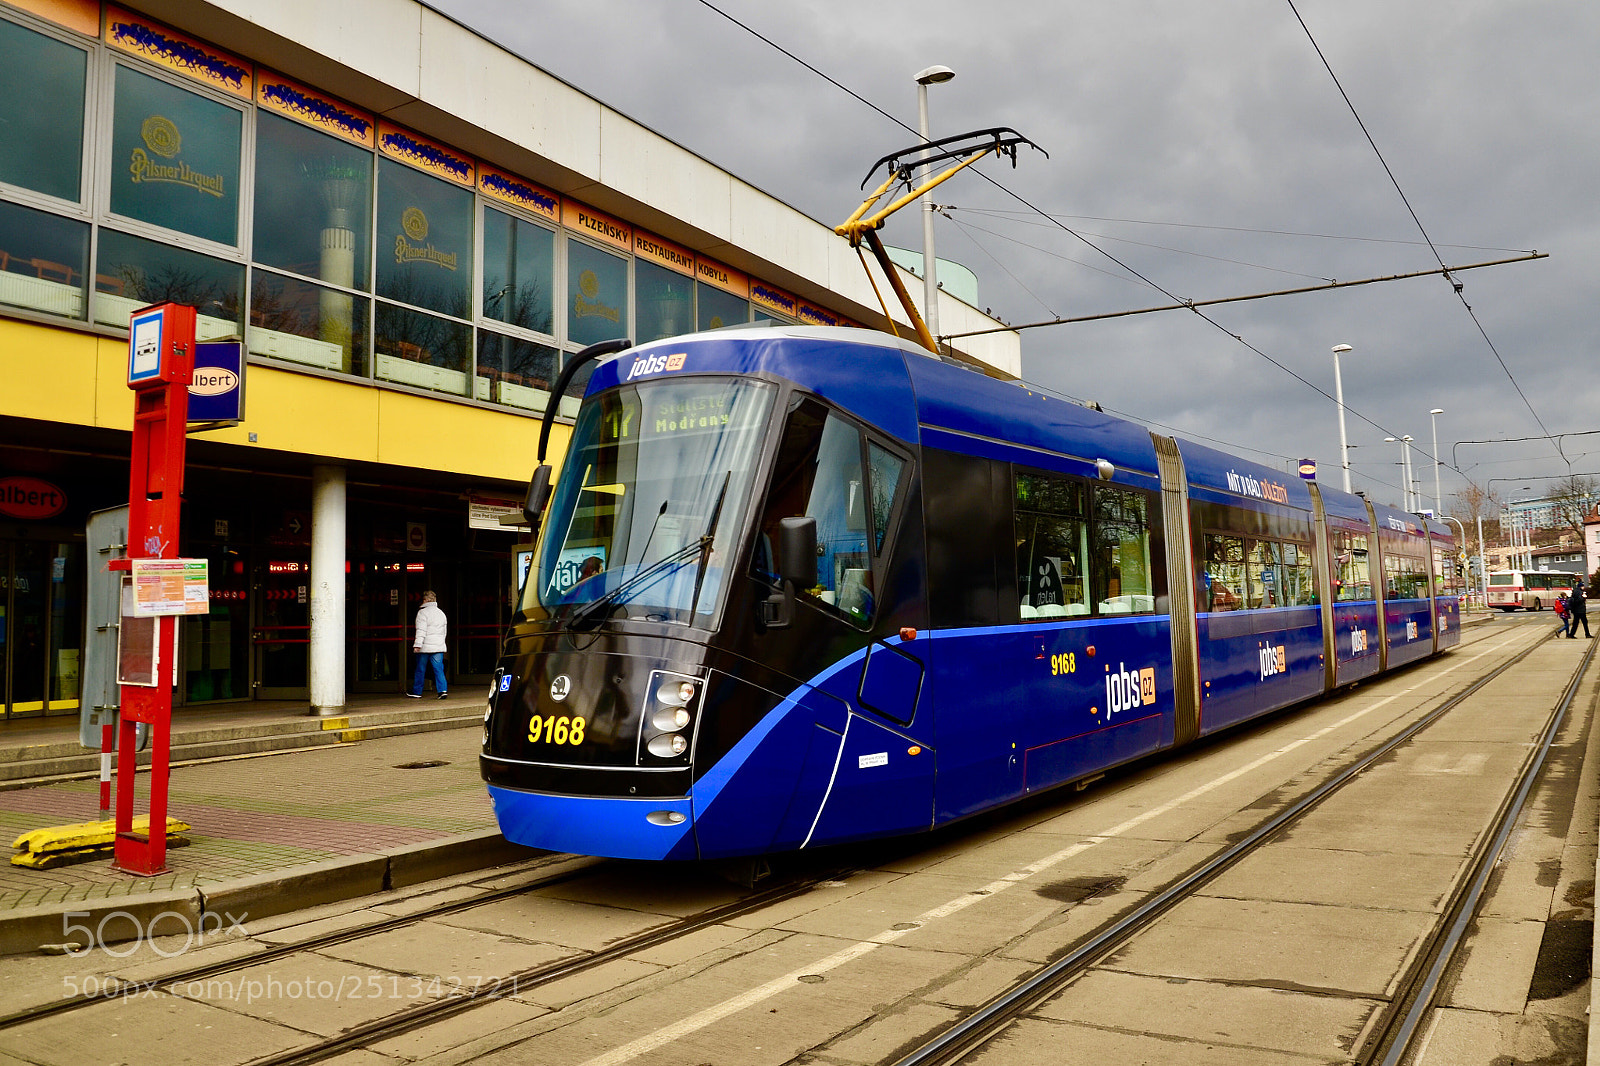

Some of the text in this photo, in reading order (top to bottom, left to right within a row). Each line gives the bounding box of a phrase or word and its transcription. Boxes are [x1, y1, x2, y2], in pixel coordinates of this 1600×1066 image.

[130, 148, 223, 193] Pilsner Urquell
[395, 235, 456, 268] Pilsner Urquell
[636, 238, 692, 269] RESTAURANT
[698, 263, 729, 284] KOBYLA
[193, 374, 231, 386] lbert
[627, 354, 667, 380] jobs
[606, 403, 634, 437] 17
[1051, 652, 1075, 676] 9168
[1259, 641, 1278, 681] jobs
[1105, 662, 1140, 720] jobs
[528, 715, 585, 746] 9168
